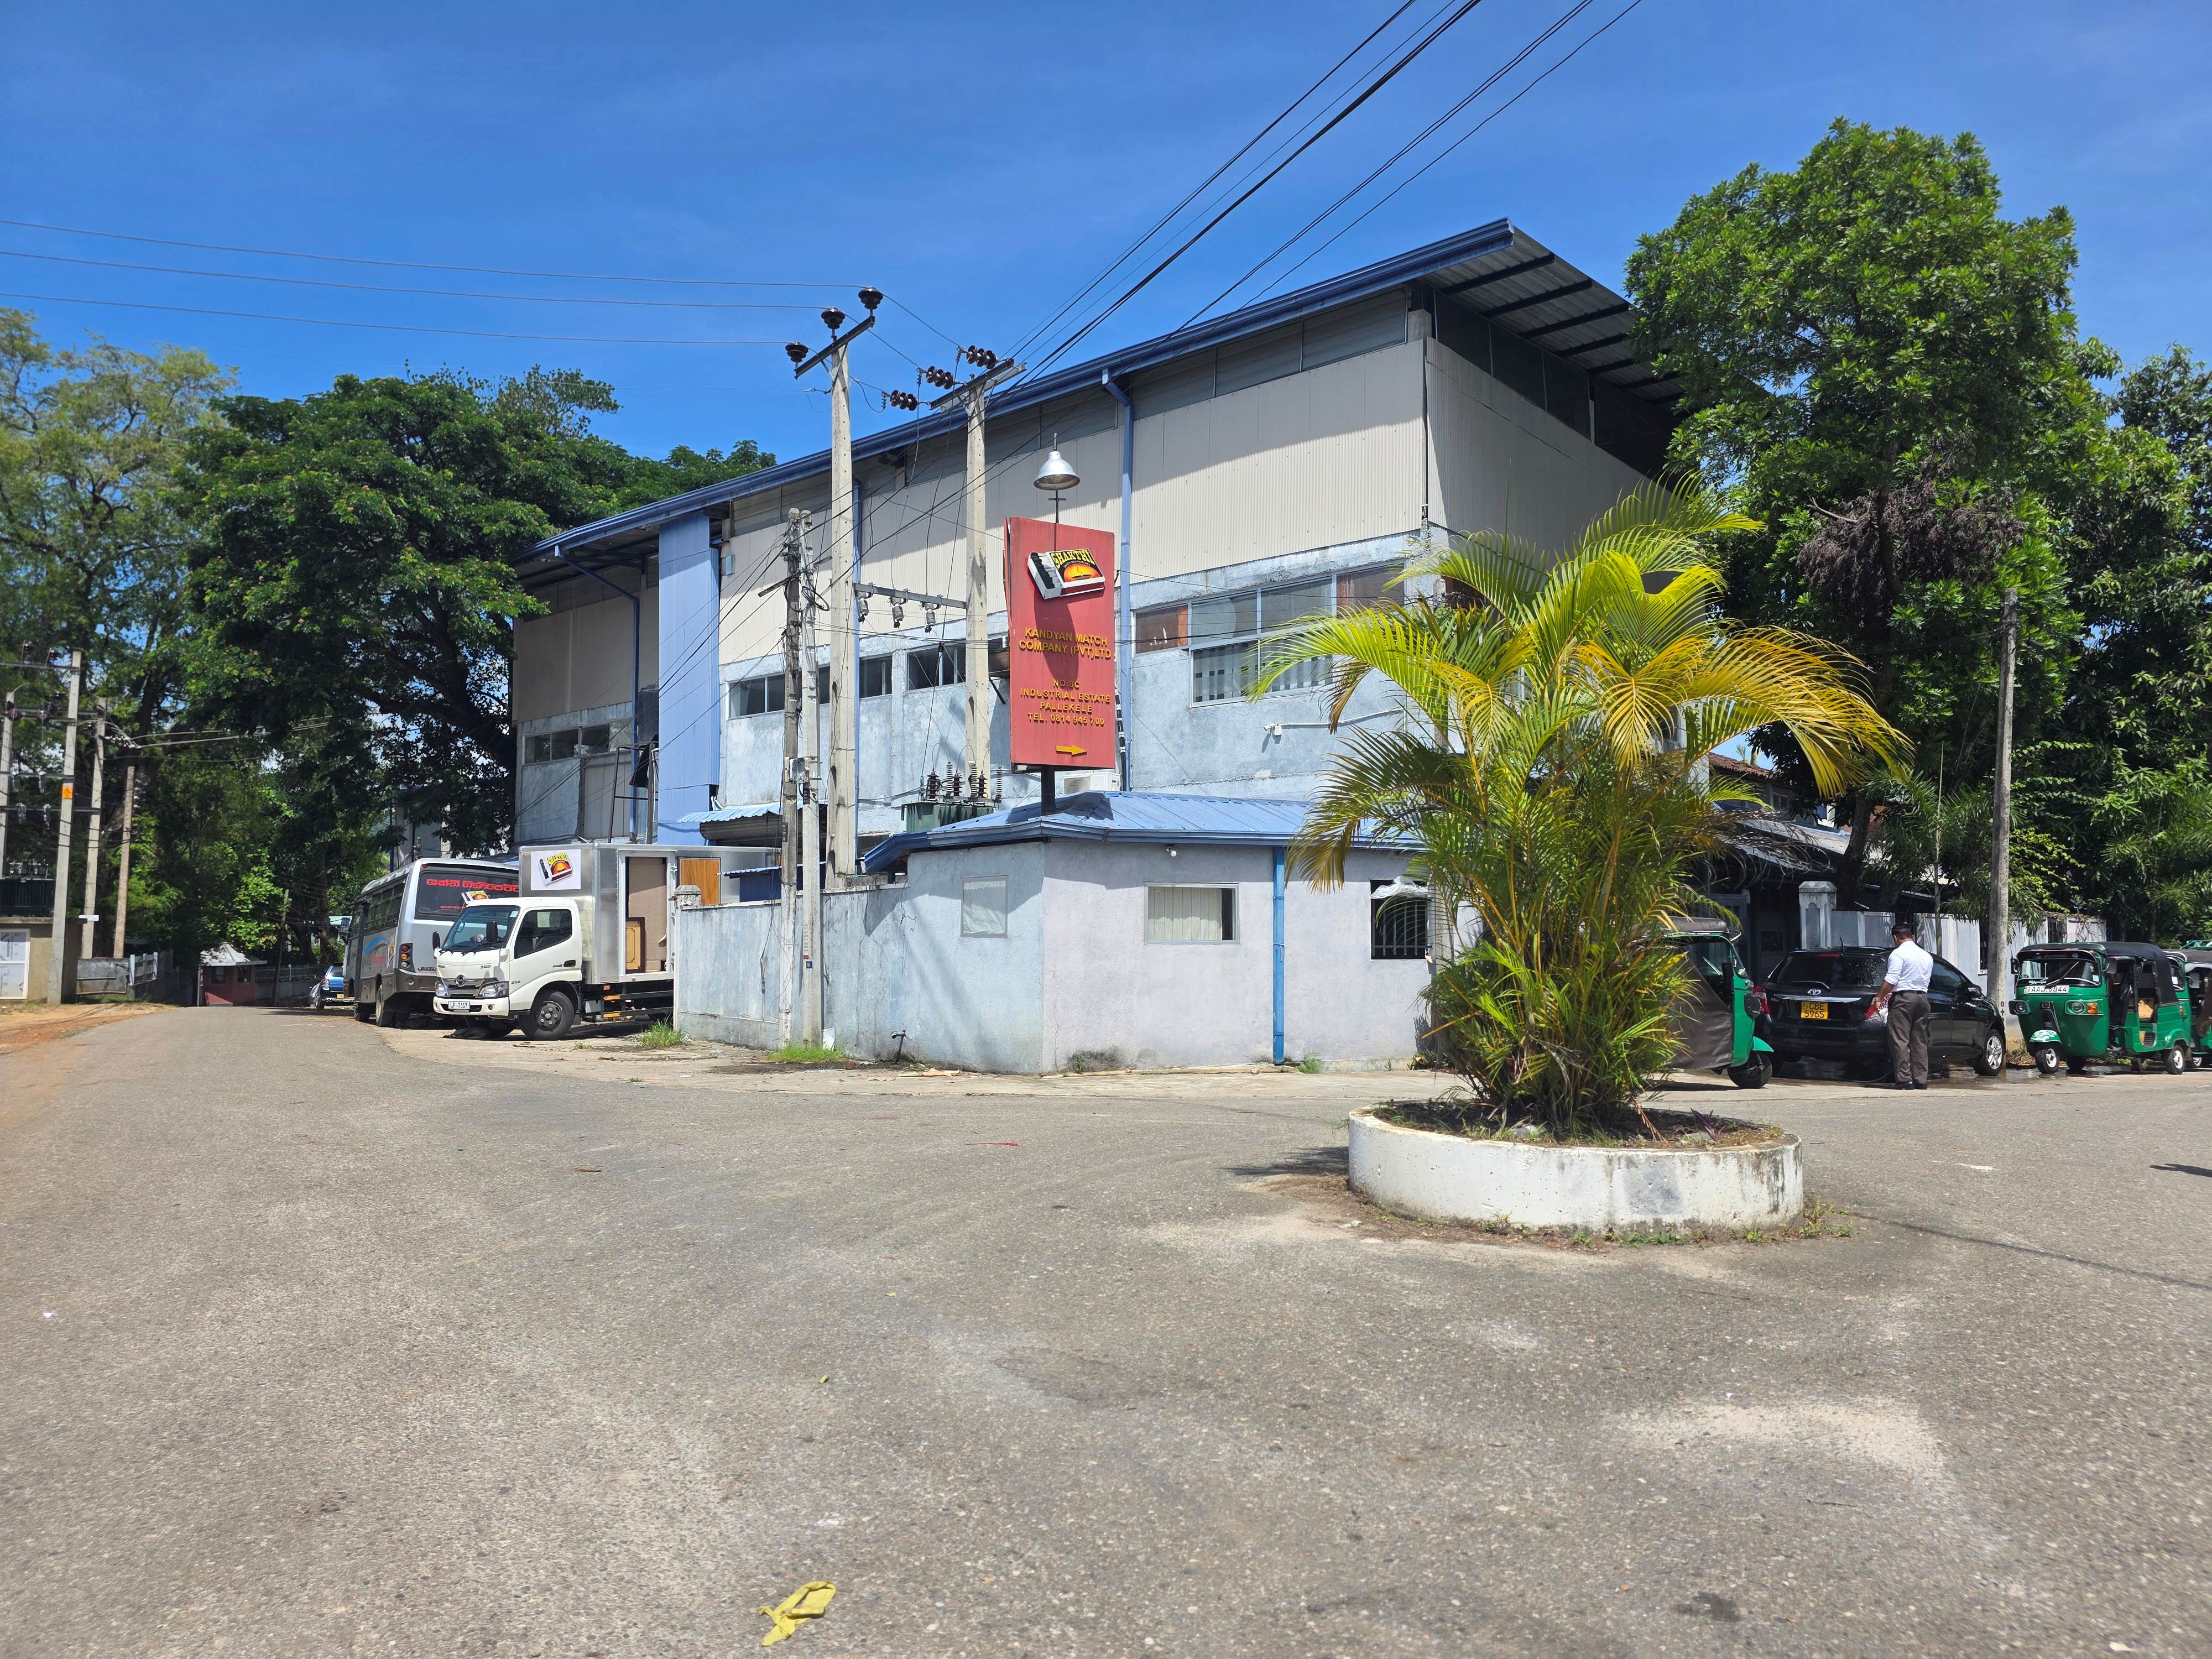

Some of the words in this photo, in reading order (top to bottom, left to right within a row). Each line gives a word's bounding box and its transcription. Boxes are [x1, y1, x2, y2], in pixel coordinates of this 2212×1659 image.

[1051, 550, 1095, 570] SHAKTHI
[1025, 628, 1072, 641] KANDYAN
[1075, 633, 1108, 646] MATCH
[1019, 640, 1067, 653] COMPANY
[1020, 688, 1075, 700] INDUSTRIAL
[1078, 693, 1110, 702] ESTATE
[1040, 701, 1092, 712] PALLEKELE
[1027, 713, 1048, 721] TEL.
[1051, 714, 1071, 722] 0814
[1809, 1002, 1825, 1011] CBE
